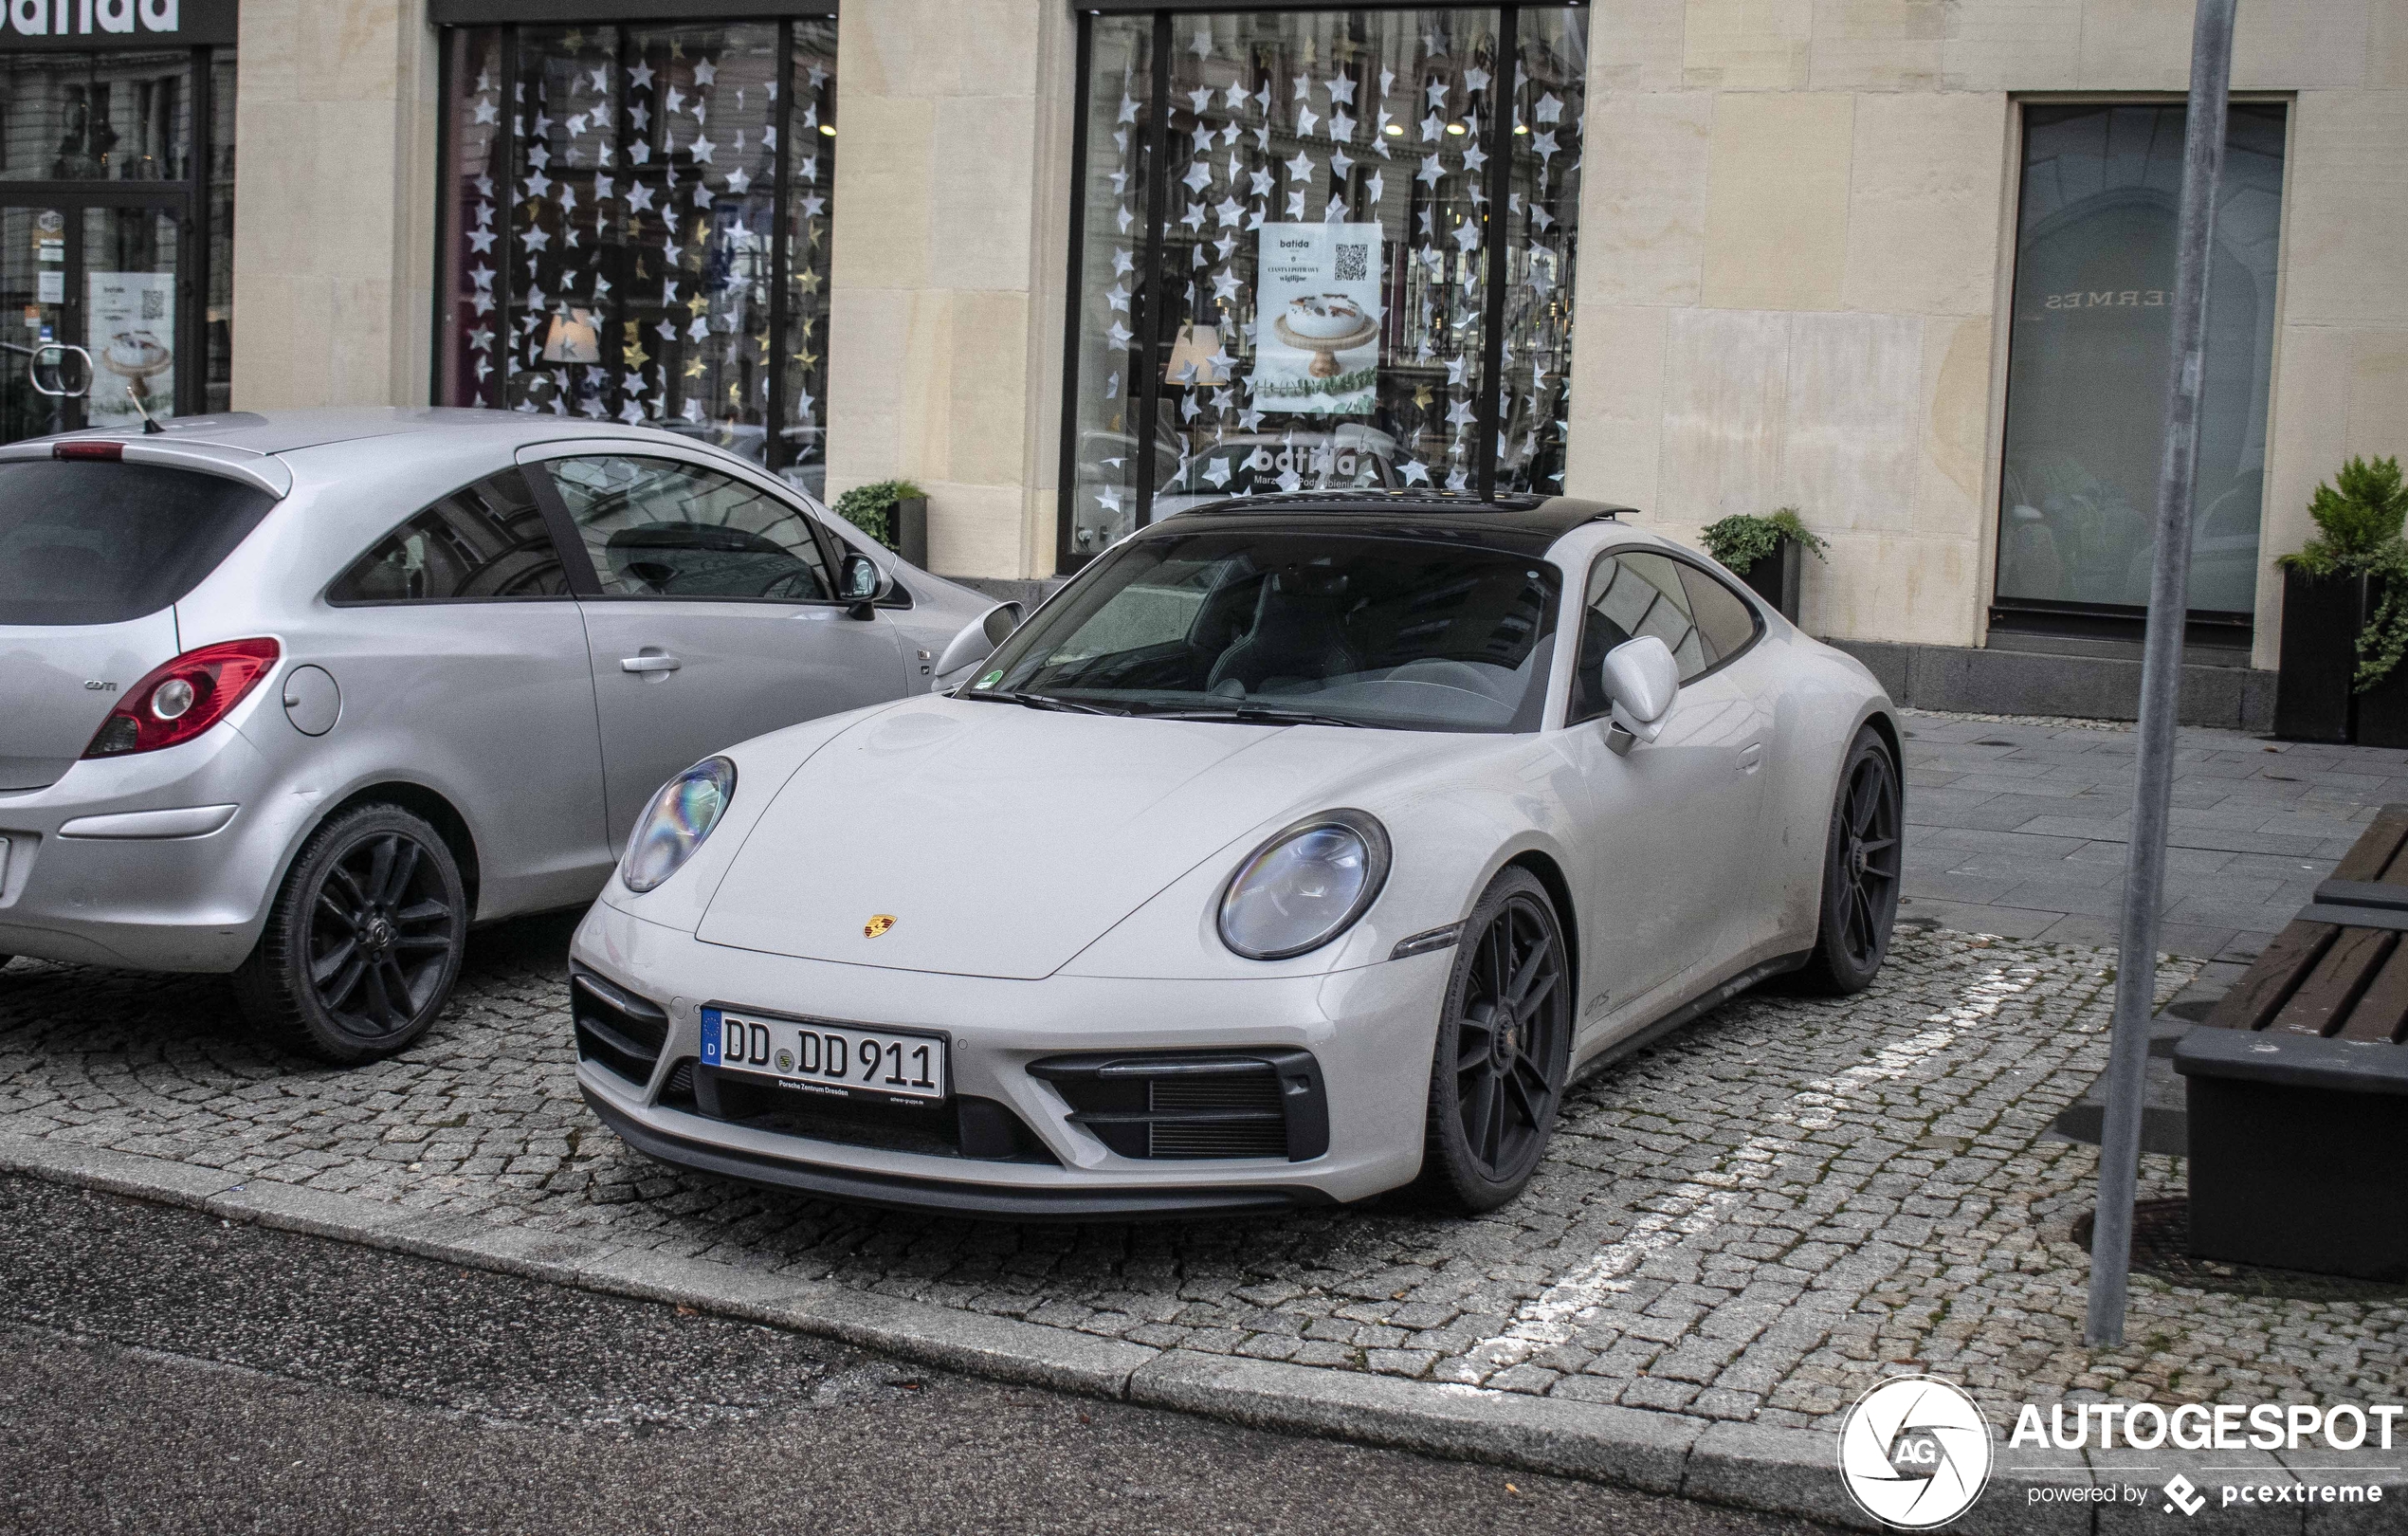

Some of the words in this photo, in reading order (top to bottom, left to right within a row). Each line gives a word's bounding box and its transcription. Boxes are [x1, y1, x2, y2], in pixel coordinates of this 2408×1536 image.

[707, 1043, 716, 1056] D
[723, 1017, 771, 1066] DD
[797, 1029, 848, 1078] DD
[859, 1038, 936, 1088] 911
[778, 1079, 801, 1089] Porsche
[801, 1084, 825, 1093] Zentrum
[825, 1087, 848, 1096] Dresden
